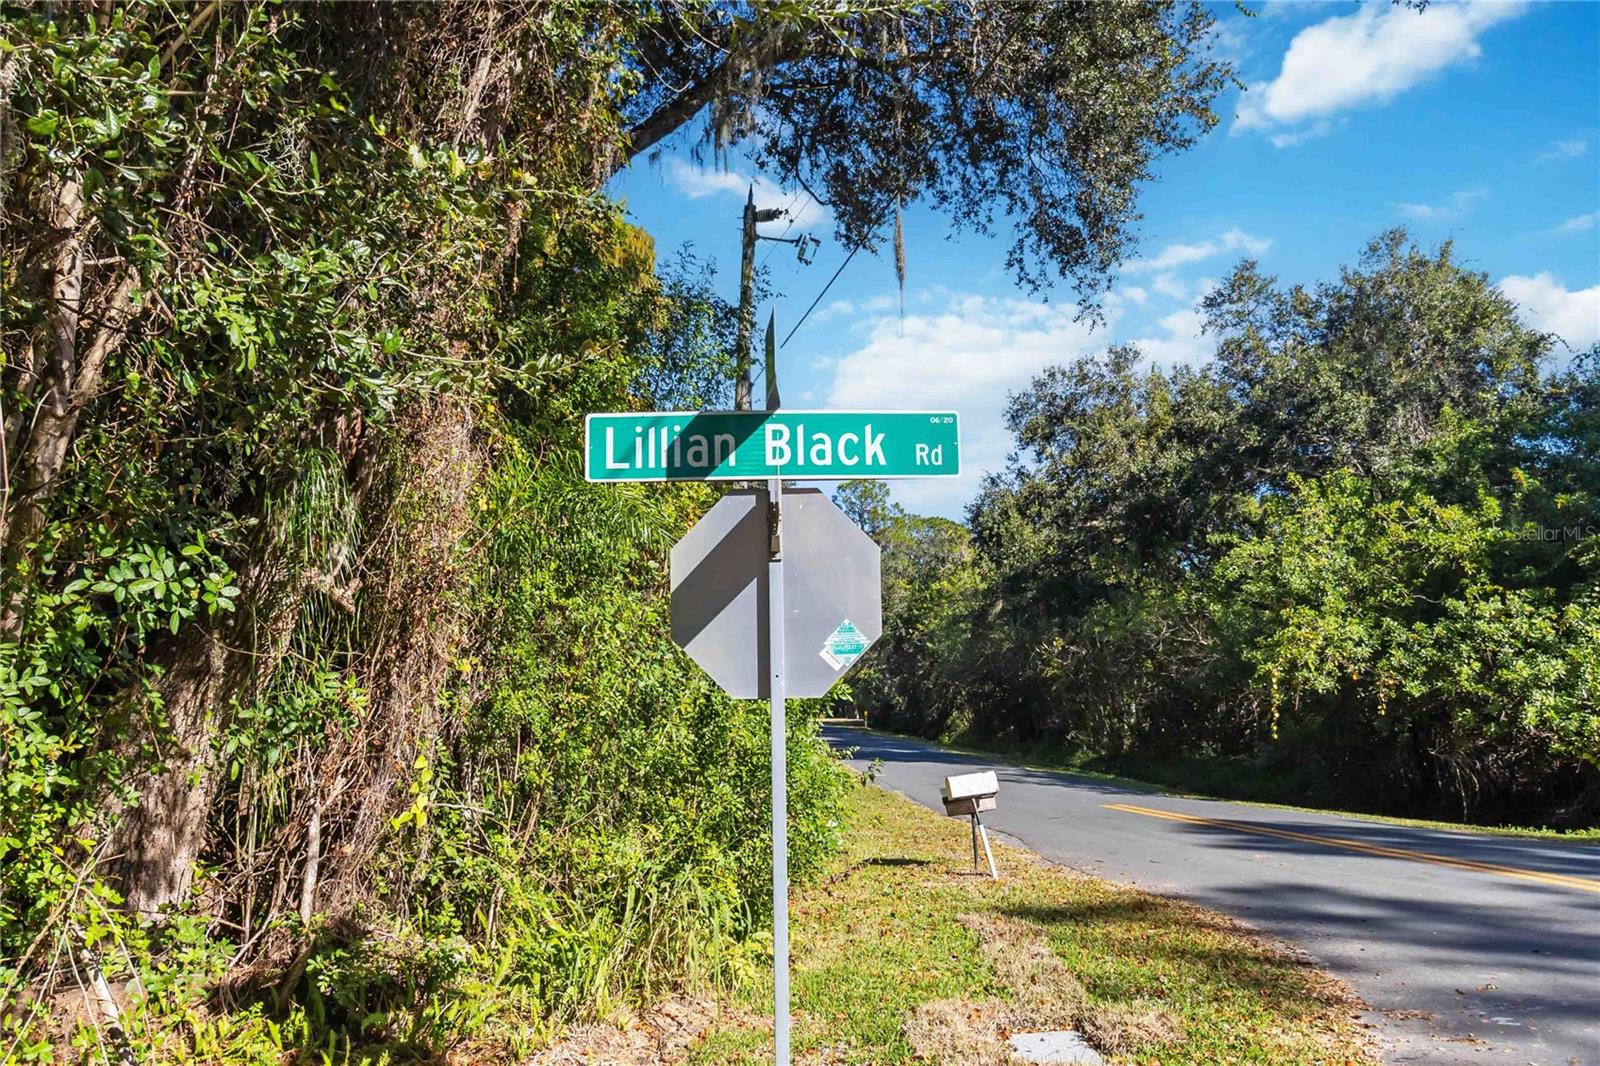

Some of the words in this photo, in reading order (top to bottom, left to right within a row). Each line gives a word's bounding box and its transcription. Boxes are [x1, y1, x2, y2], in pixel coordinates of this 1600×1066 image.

[930, 416, 954, 425] 06/20
[605, 425, 736, 469] Lillian
[764, 423, 887, 467] Black
[915, 443, 943, 466] Rd
